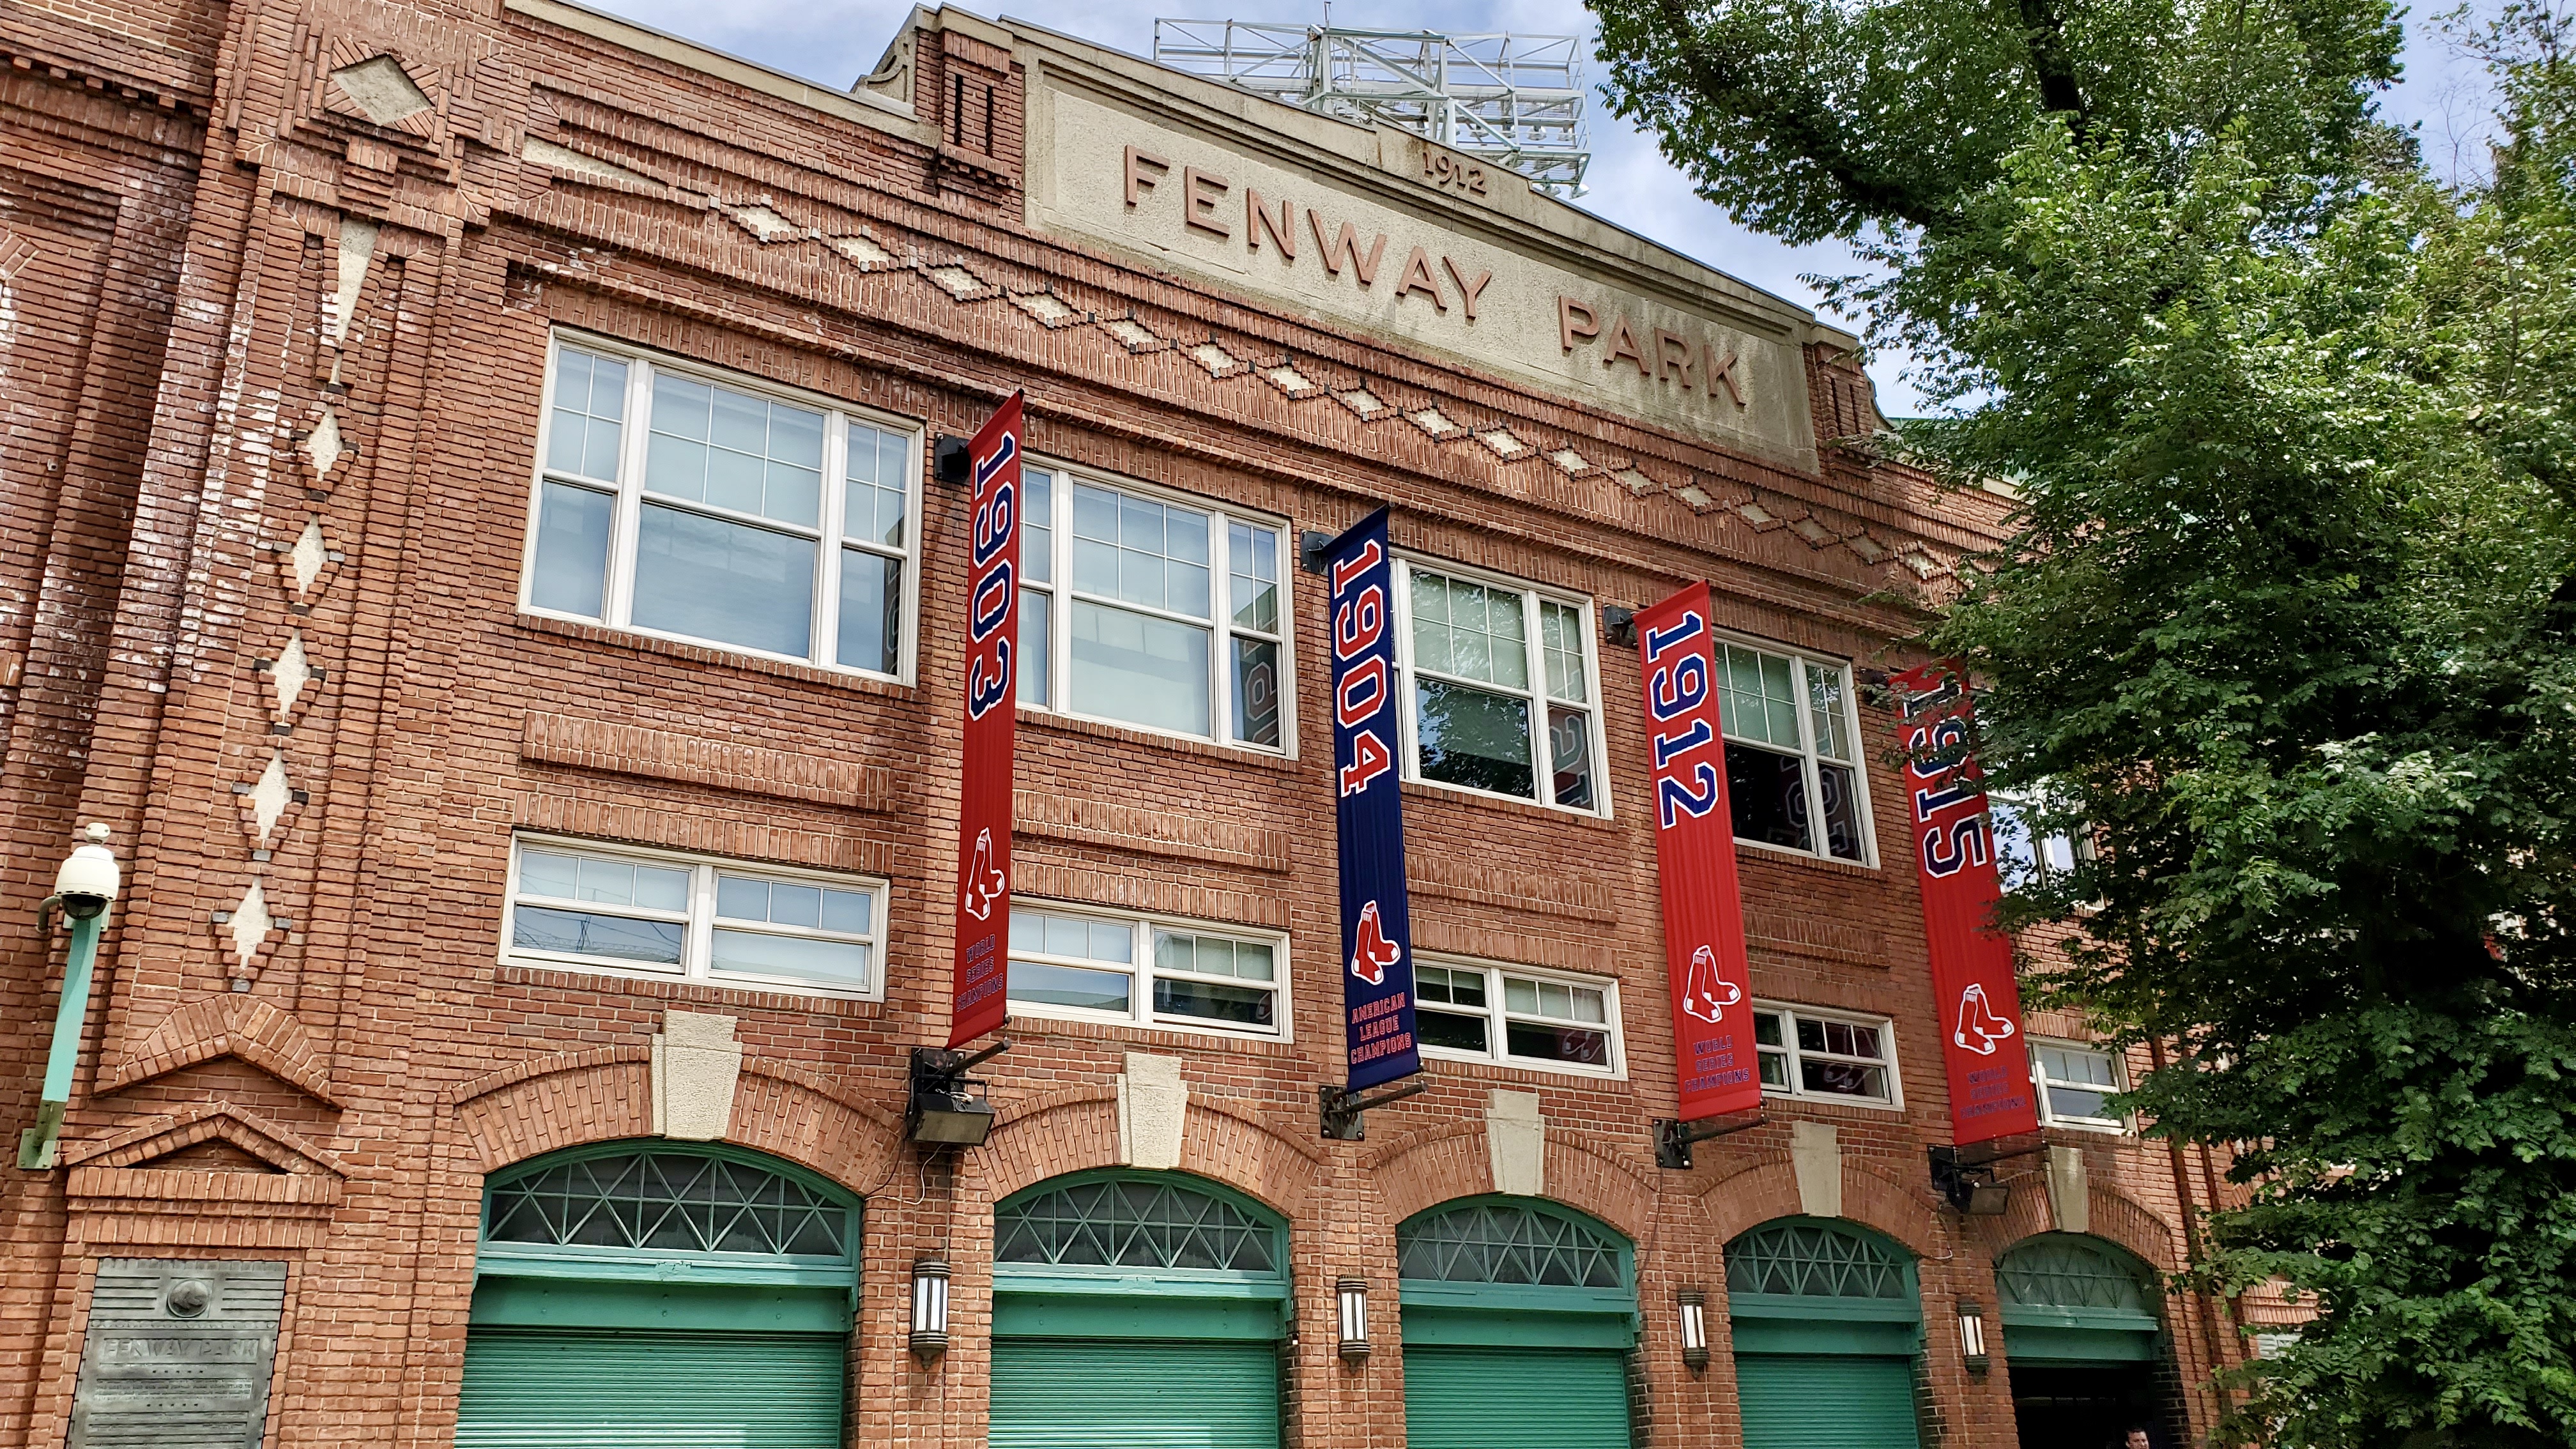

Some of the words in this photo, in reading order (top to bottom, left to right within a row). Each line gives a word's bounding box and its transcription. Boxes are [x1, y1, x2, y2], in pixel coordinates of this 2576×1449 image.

[1423, 151, 1487, 195] 1912
[1123, 143, 1491, 319] FENWAY
[1558, 294, 1746, 406] PARK
[969, 430, 1016, 721] 1903
[1333, 538, 1391, 798] 1904
[1646, 610, 1719, 831] 1912
[1903, 680, 1988, 878] 1915
[966, 934, 995, 963] WORLD
[966, 956, 995, 985] SERIES
[956, 974, 1004, 1012] CHAMPIONS
[1352, 992, 1406, 1024] AMERICAN
[1360, 1015, 1399, 1041] LEAGUE
[1351, 1032, 1411, 1065] CHAMPIONS
[1693, 1035, 1733, 1055] WORLD
[1696, 1053, 1734, 1073] SERIES
[1966, 1065, 2008, 1084] WORLD
[1685, 1068, 1750, 1094] CHAMPIONS
[1970, 1082, 2010, 1100] SERIES
[1959, 1095, 2027, 1119] CHAMPIONS
[104, 1340, 190, 1356] FENWAY
[200, 1340, 257, 1356] PARK
